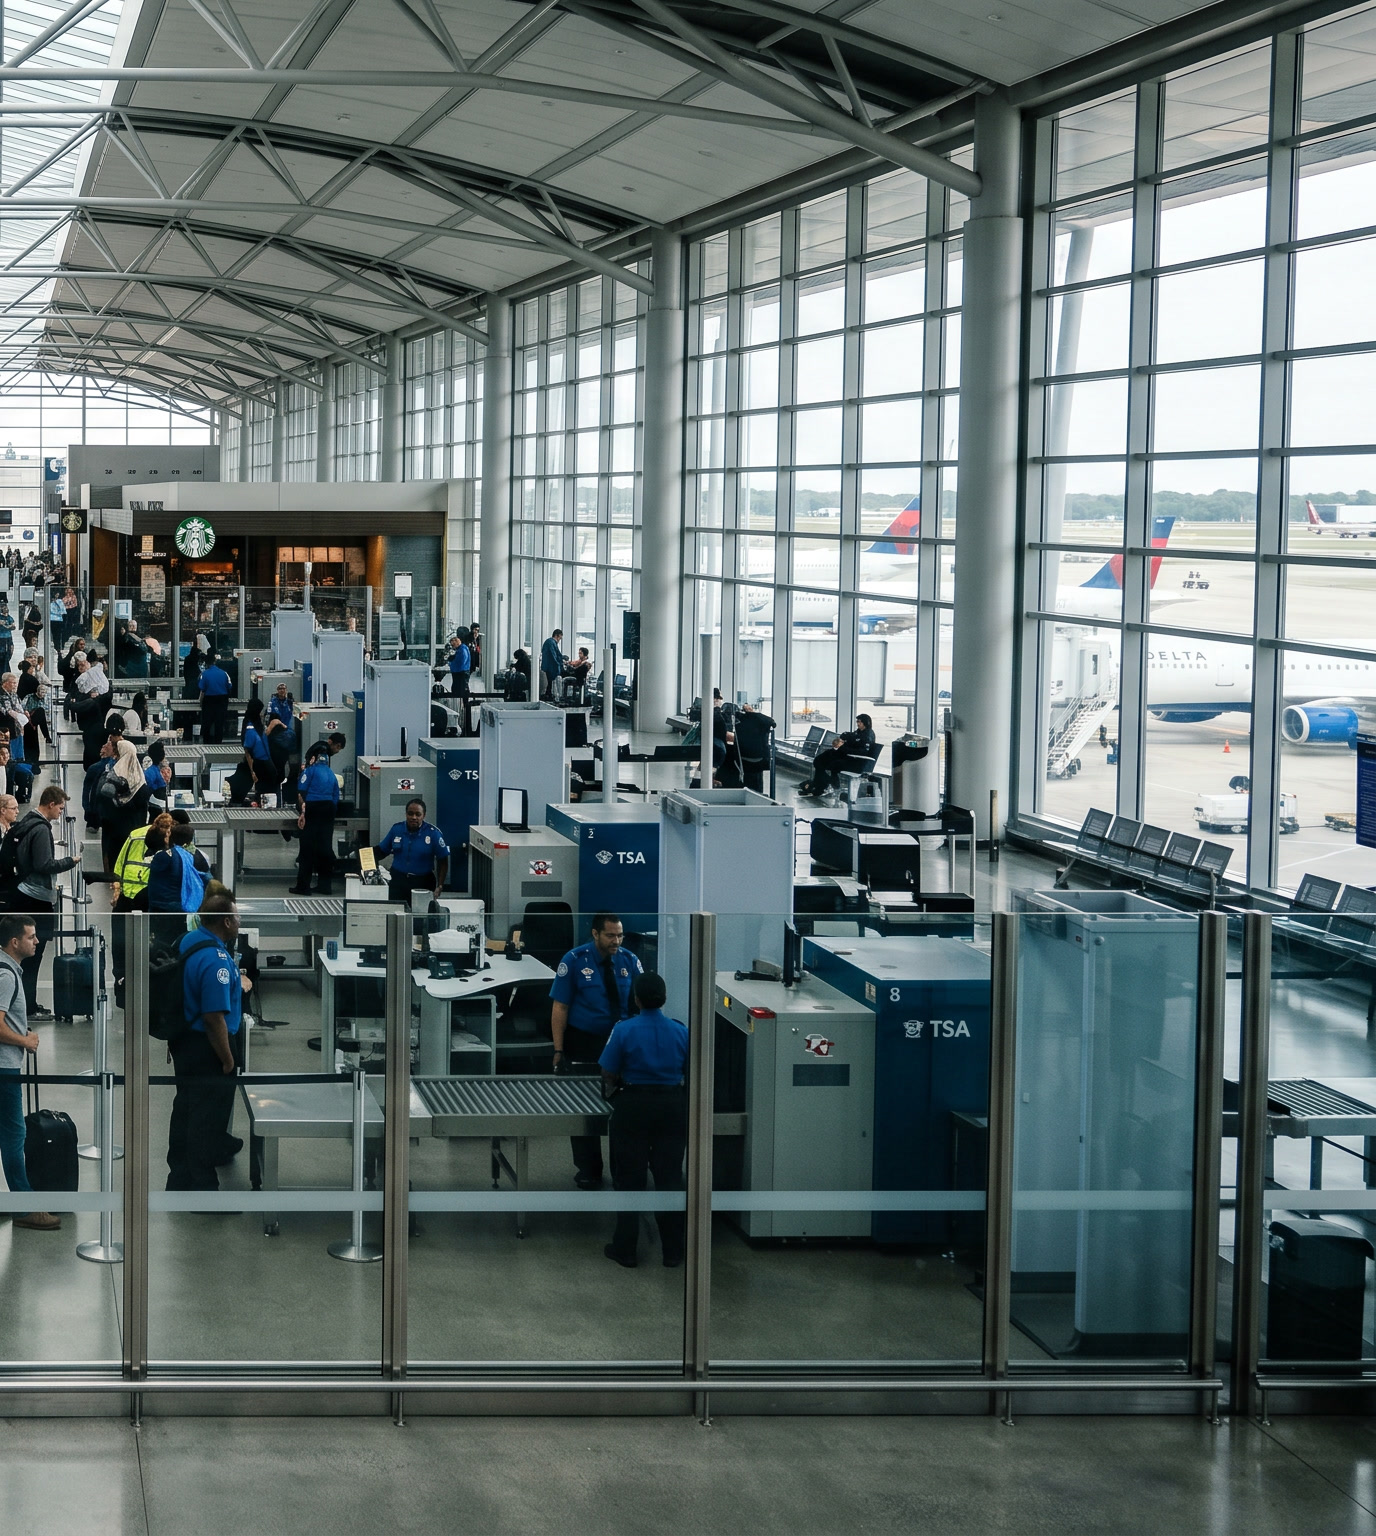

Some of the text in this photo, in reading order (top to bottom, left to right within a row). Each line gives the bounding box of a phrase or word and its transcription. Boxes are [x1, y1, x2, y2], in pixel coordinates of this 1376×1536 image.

[1147, 651, 1207, 661] DELTA
[464, 770, 480, 780] TS
[616, 851, 646, 864] TSA
[889, 987, 901, 1002] 8
[929, 1020, 971, 1038] TSA
